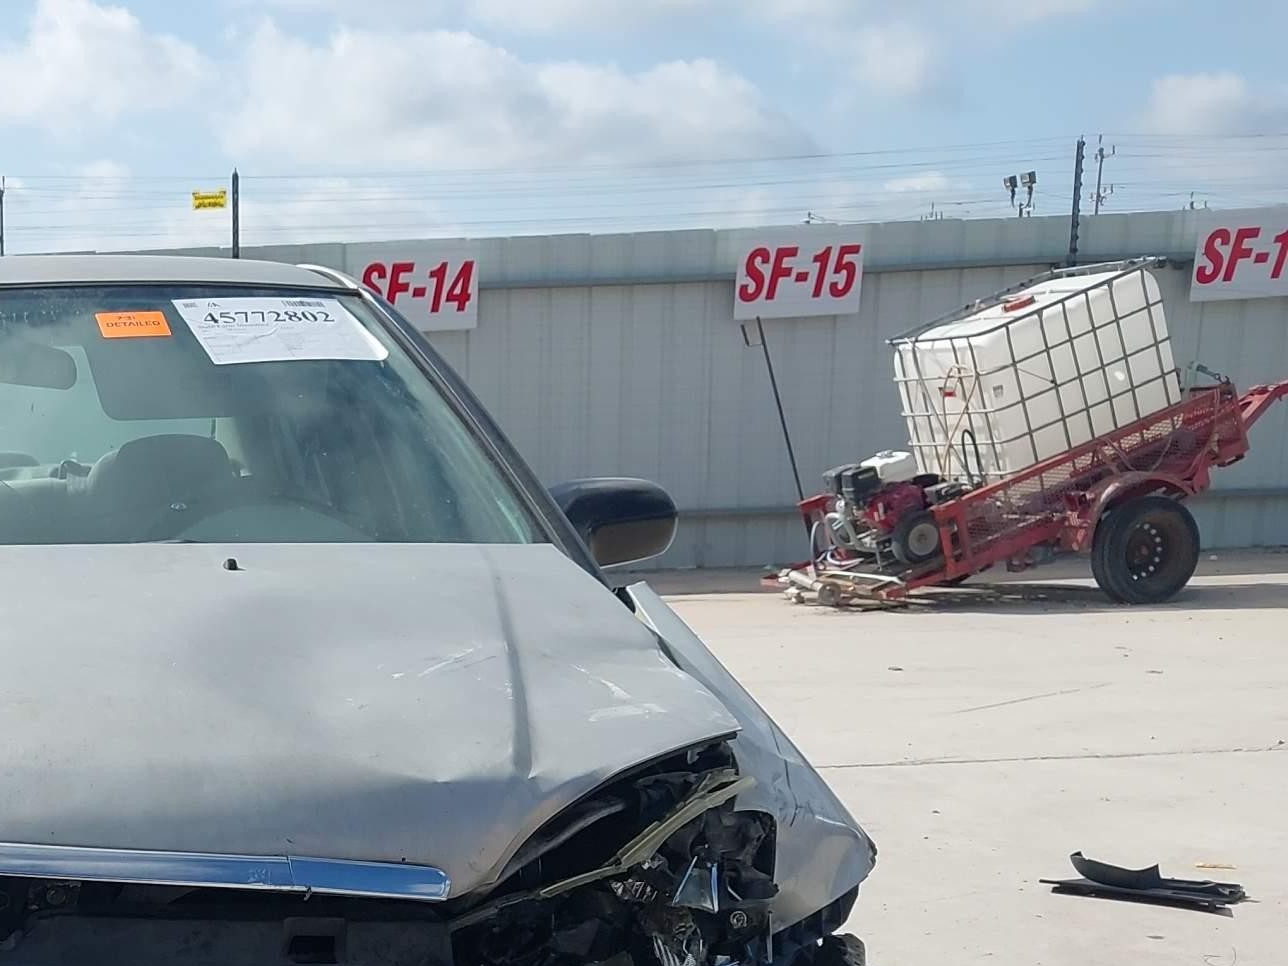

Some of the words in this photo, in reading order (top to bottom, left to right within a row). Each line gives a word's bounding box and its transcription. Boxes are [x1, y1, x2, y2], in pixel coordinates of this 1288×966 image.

[362, 261, 474, 313] SF-14
[738, 244, 862, 302] SF-15
[106, 320, 160, 328] DETAILED
[203, 311, 335, 325] 45772802
